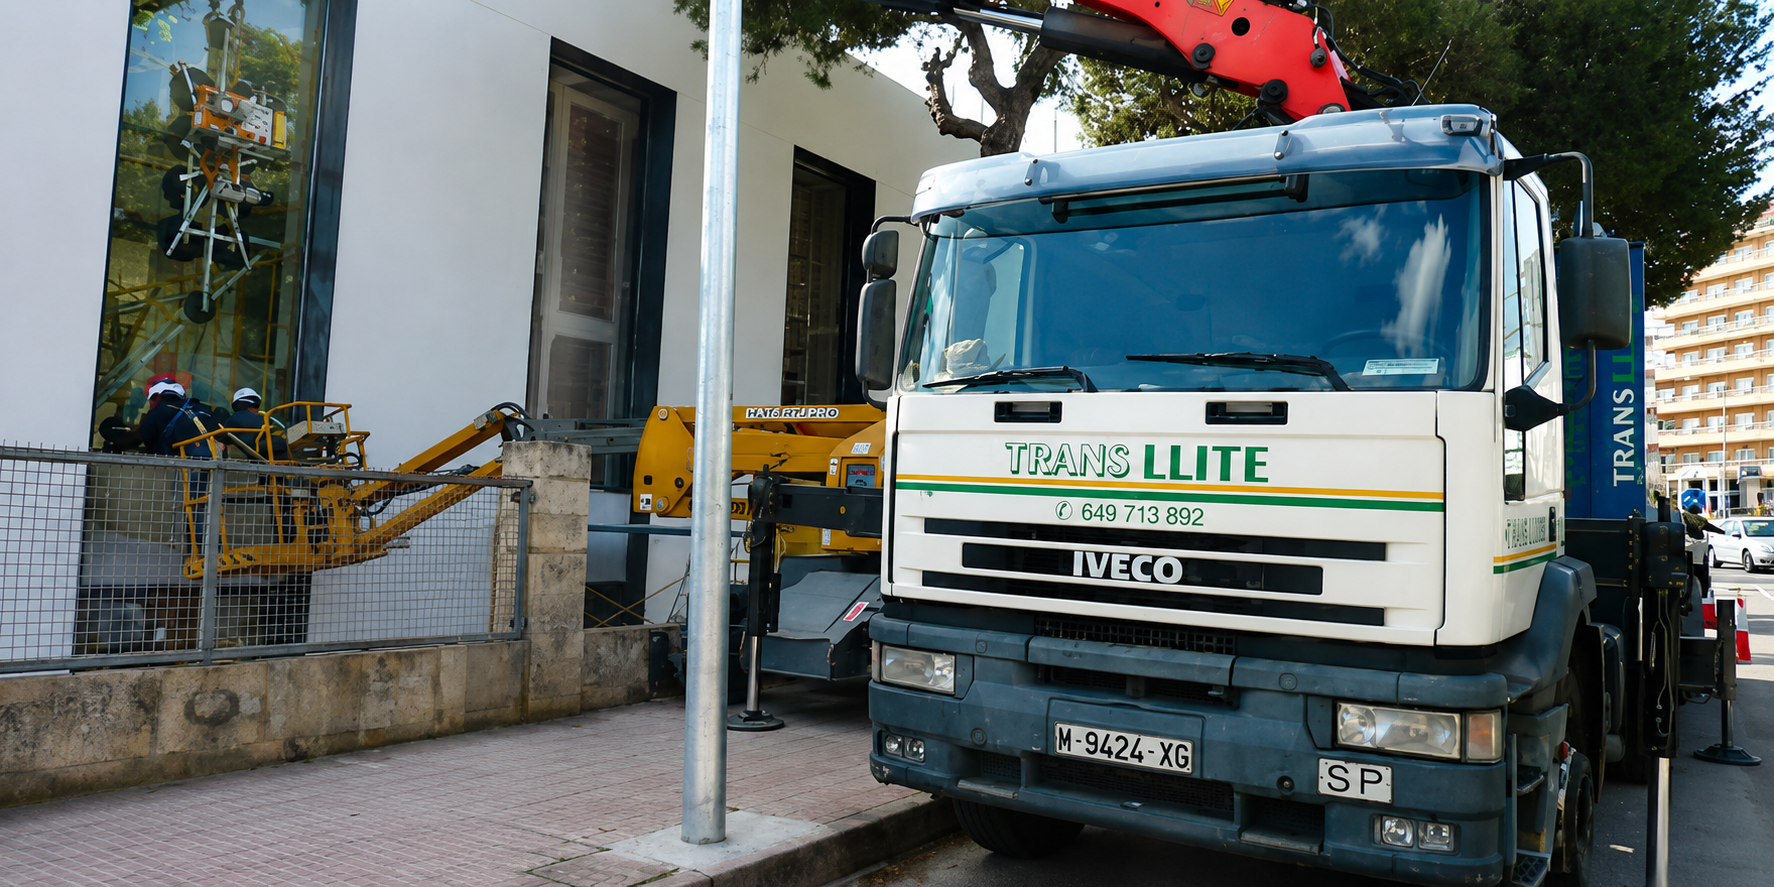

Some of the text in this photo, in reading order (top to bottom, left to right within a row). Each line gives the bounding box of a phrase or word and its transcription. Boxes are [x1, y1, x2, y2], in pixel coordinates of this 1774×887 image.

[808, 408, 838, 418] PRO
[1612, 388, 1635, 487] TRANS
[1005, 442, 1269, 482] TRANS LLITE
[1081, 503, 1204, 526] 649 713 892
[1073, 551, 1183, 584] IVECO
